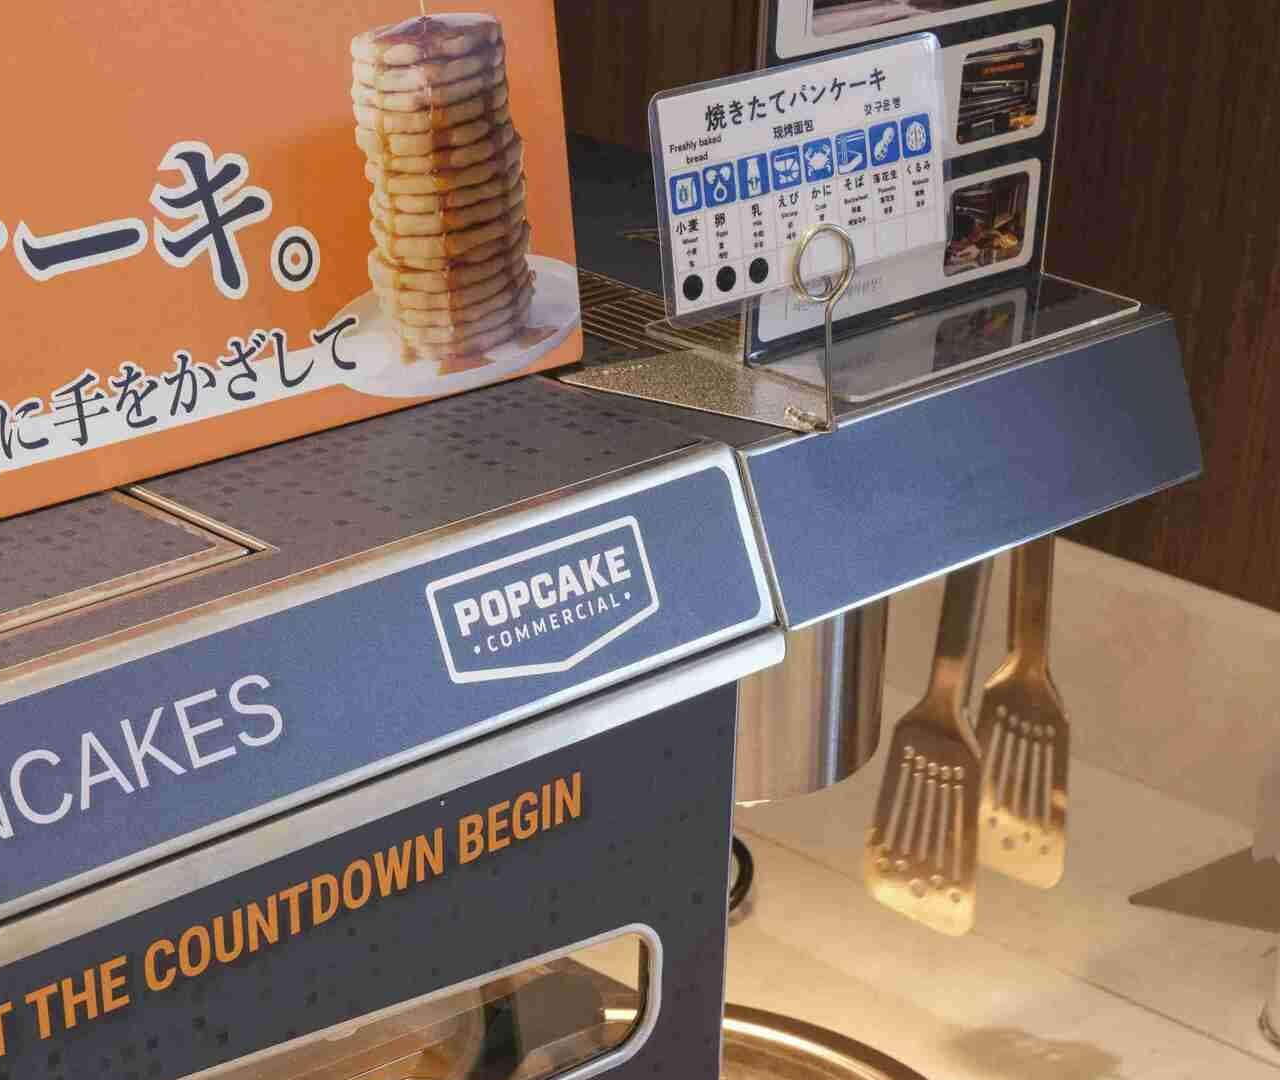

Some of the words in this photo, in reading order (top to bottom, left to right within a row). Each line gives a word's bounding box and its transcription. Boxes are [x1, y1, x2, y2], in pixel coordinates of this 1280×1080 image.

[668, 139, 697, 154] Freshly
[699, 134, 722, 148] baked
[686, 152, 709, 165] bread
[811, 184, 832, 200] かに
[843, 175, 865, 191] そば
[777, 191, 799, 208] えび
[454, 546, 631, 637] POPCAKE
[487, 592, 620, 653] COMMERCIAL
[24, 955, 129, 1041] THE
[144, 827, 444, 992] COUNTDOWN
[456, 771, 583, 867] BEGIN
